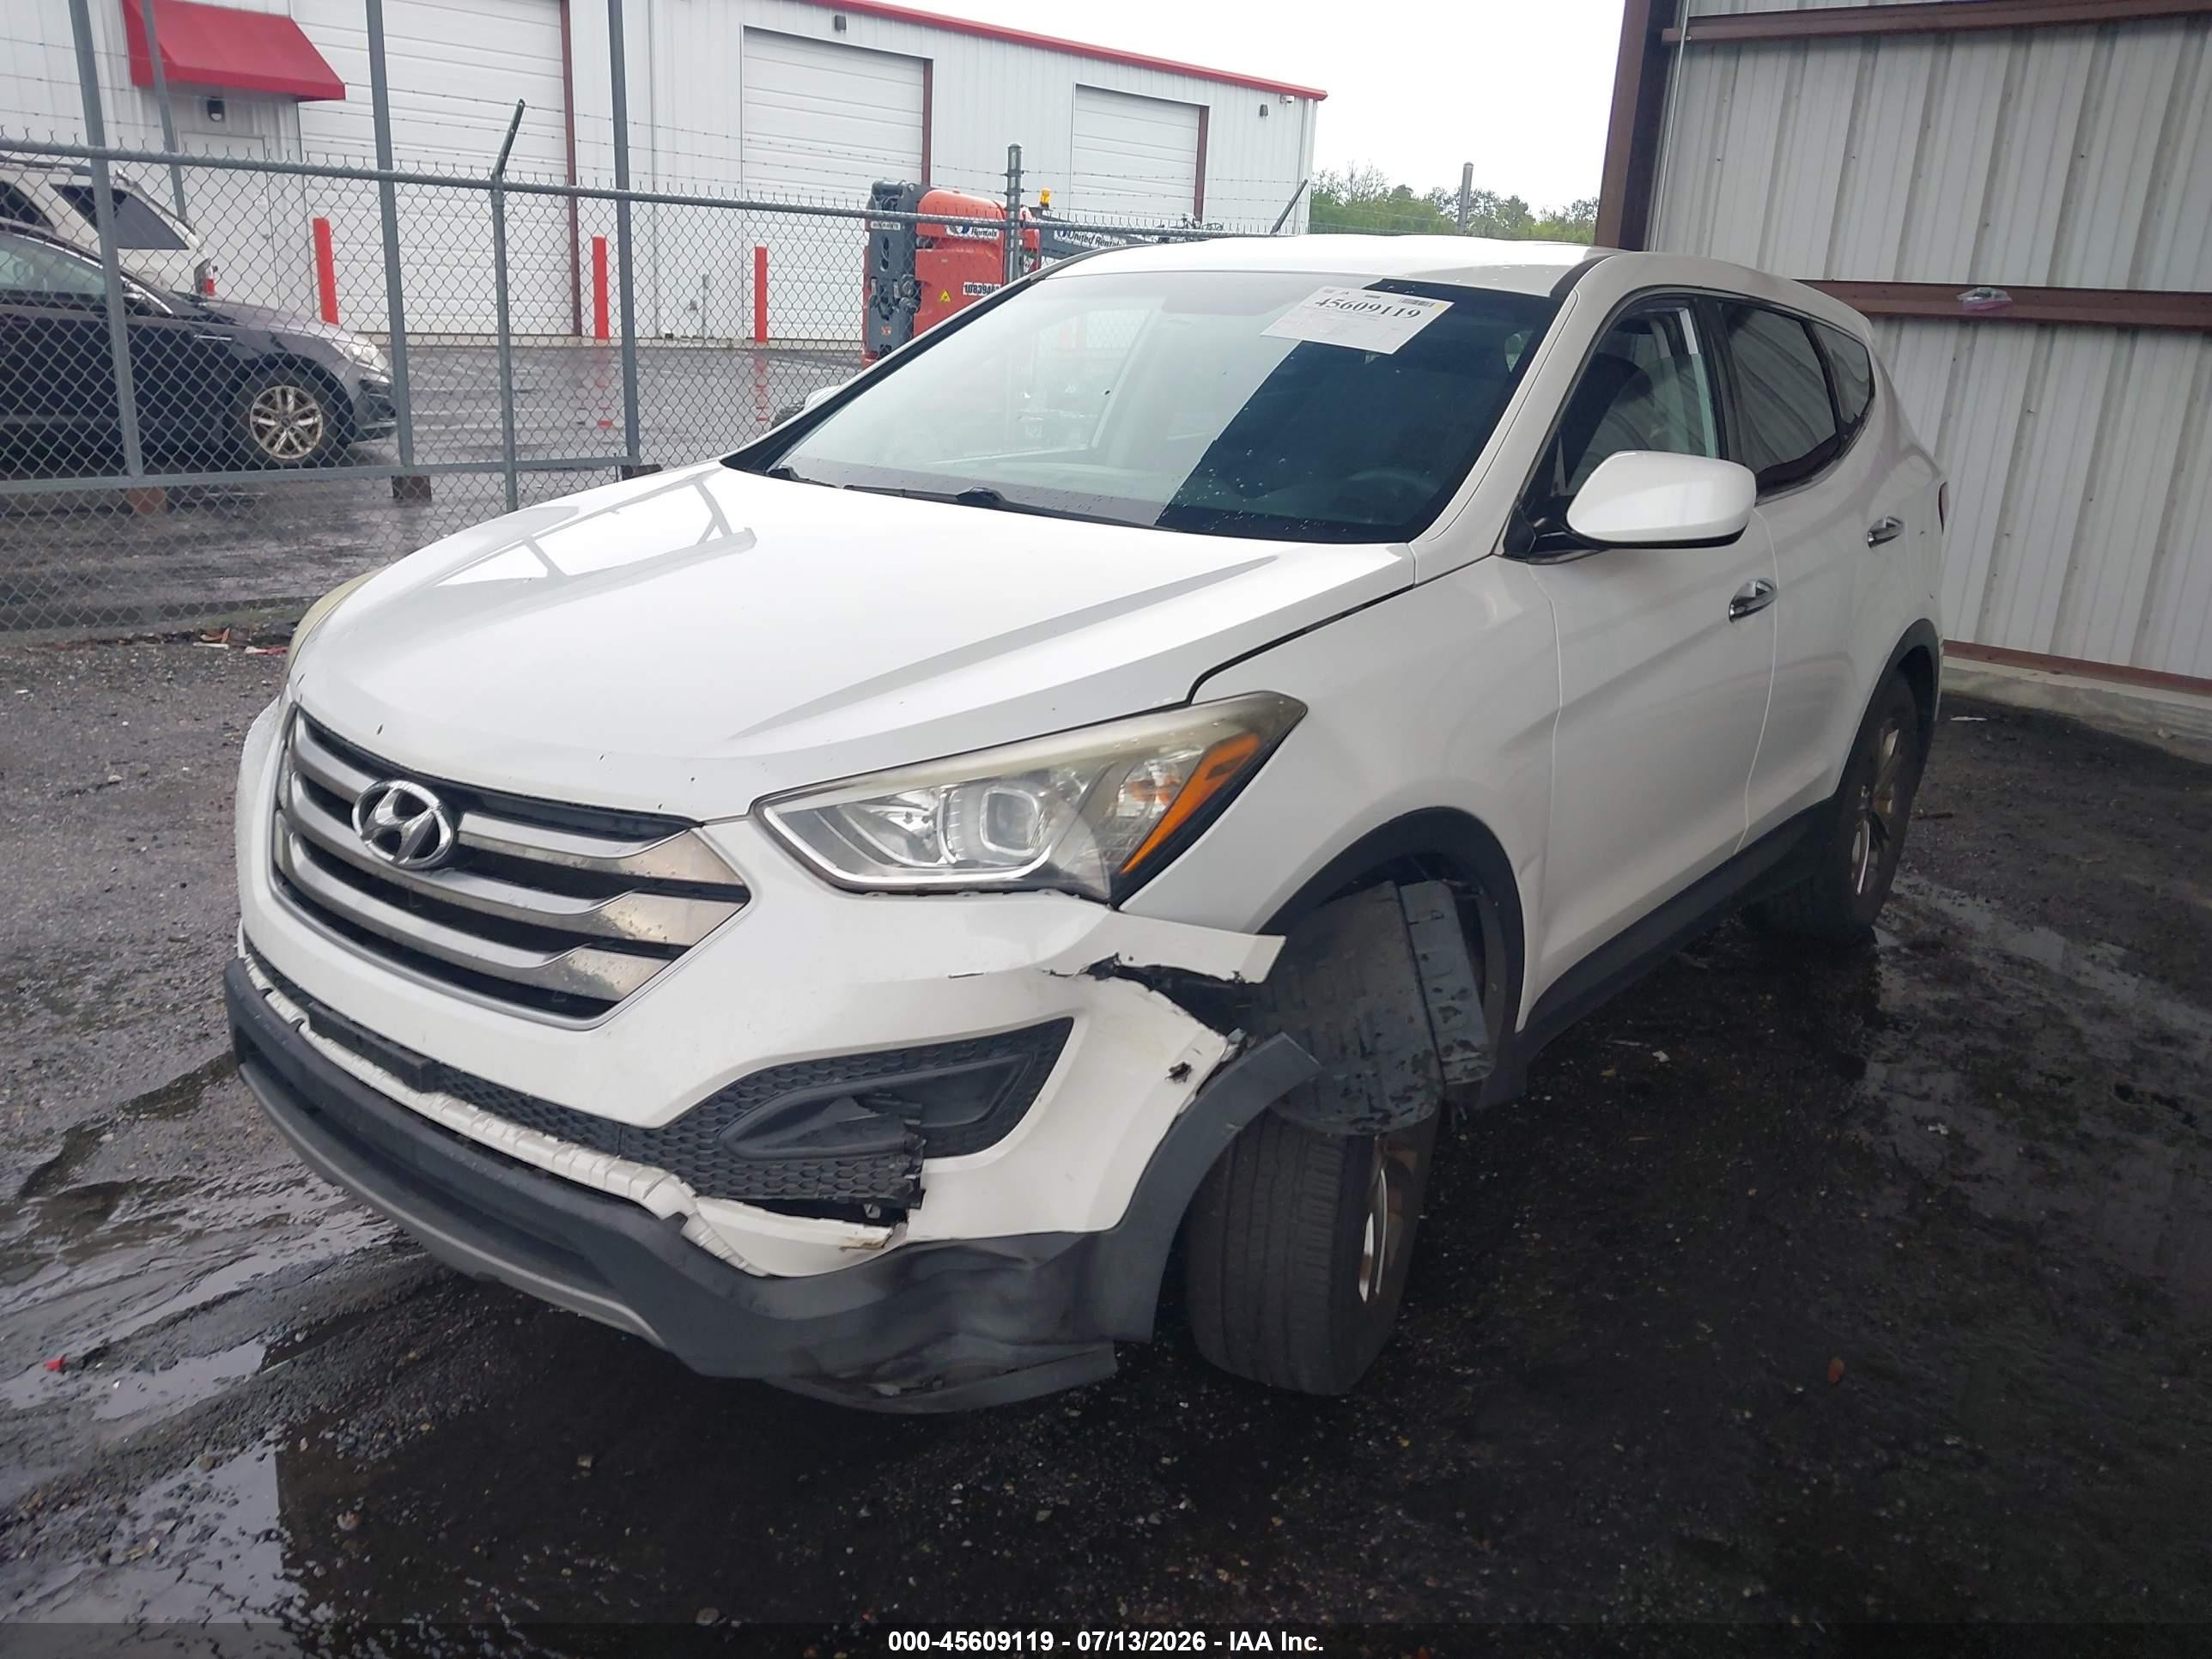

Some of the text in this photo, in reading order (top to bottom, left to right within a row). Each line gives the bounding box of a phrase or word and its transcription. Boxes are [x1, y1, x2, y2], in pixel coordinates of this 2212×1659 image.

[971, 227, 998, 237] Rentals
[1068, 229, 1096, 246] United
[1315, 297, 1422, 319] 45609119
